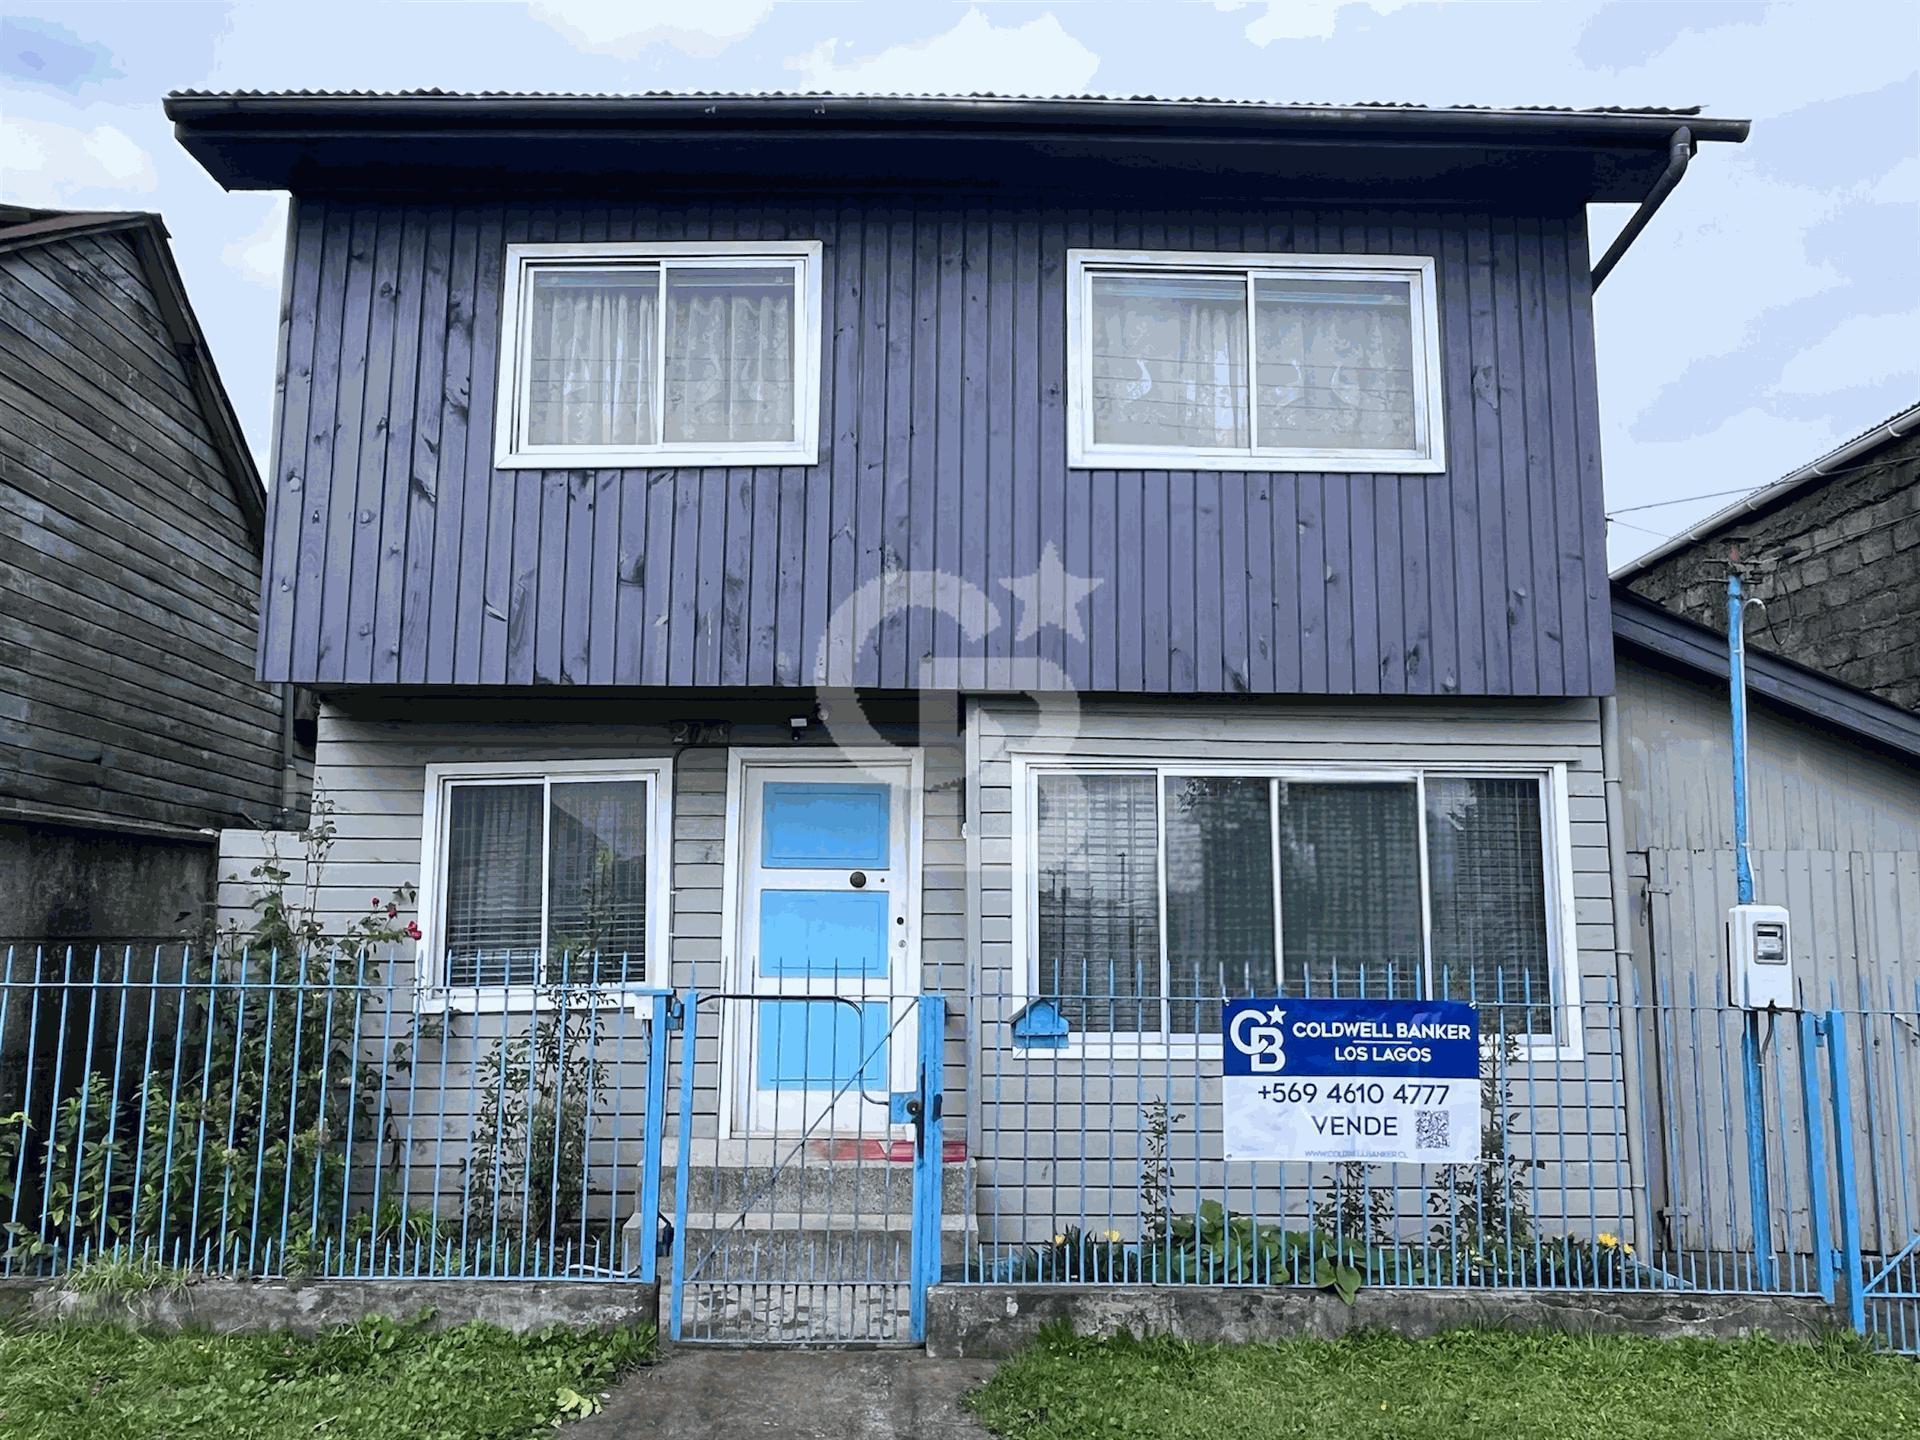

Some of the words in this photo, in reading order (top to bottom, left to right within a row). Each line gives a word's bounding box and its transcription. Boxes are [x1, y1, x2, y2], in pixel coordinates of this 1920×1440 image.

[1230, 1009, 1286, 1072] CB
[1292, 1021, 1394, 1039] COLDWELL
[1396, 1022, 1471, 1040] BANKER
[1335, 1046, 1368, 1062] LOS
[1372, 1047, 1432, 1063] LAGOS
[1258, 1083, 1317, 1103] +569
[1326, 1083, 1384, 1104] 4610
[1393, 1084, 1449, 1105] 4777
[1311, 1115, 1398, 1136] VENDE
